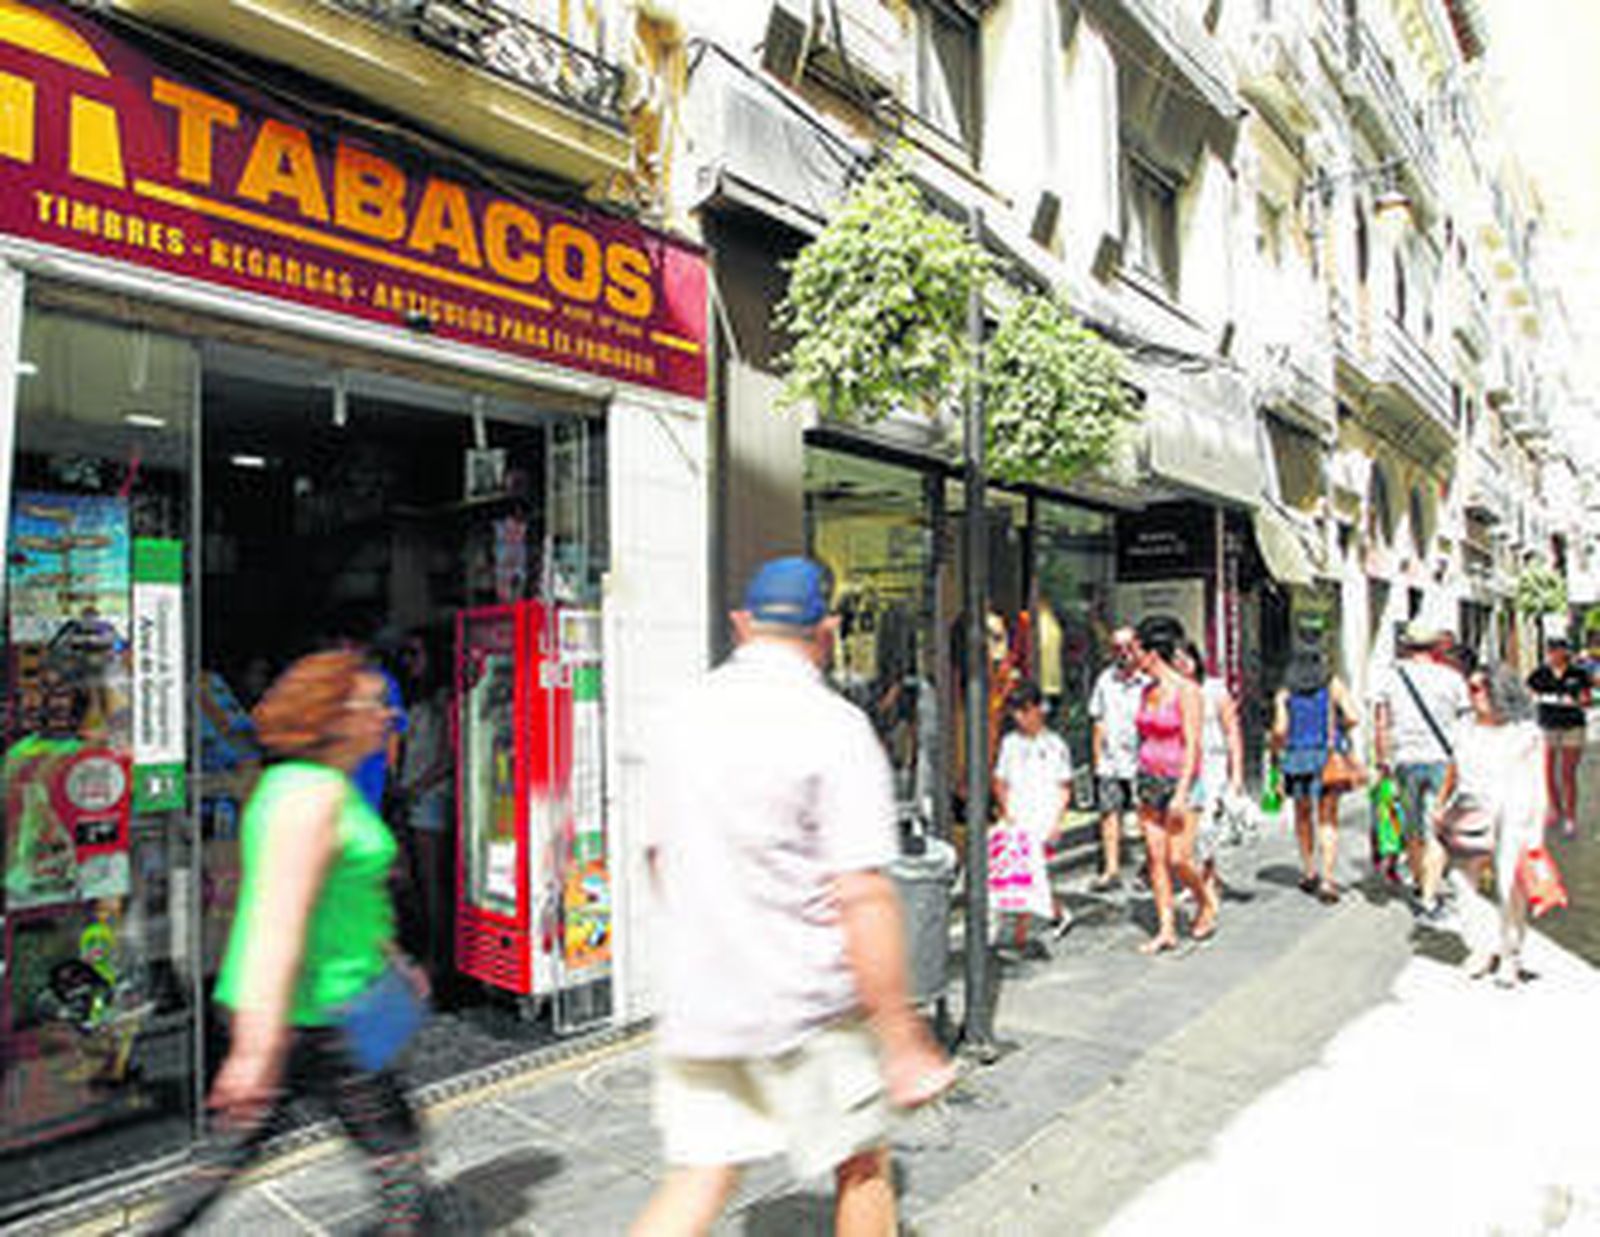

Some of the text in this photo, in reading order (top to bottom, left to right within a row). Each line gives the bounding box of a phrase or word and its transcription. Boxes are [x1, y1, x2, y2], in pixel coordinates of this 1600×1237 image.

[35, 189, 186, 257] TIMBRES
[501, 315, 551, 348] PARA
[152, 77, 655, 318] TABACOS
